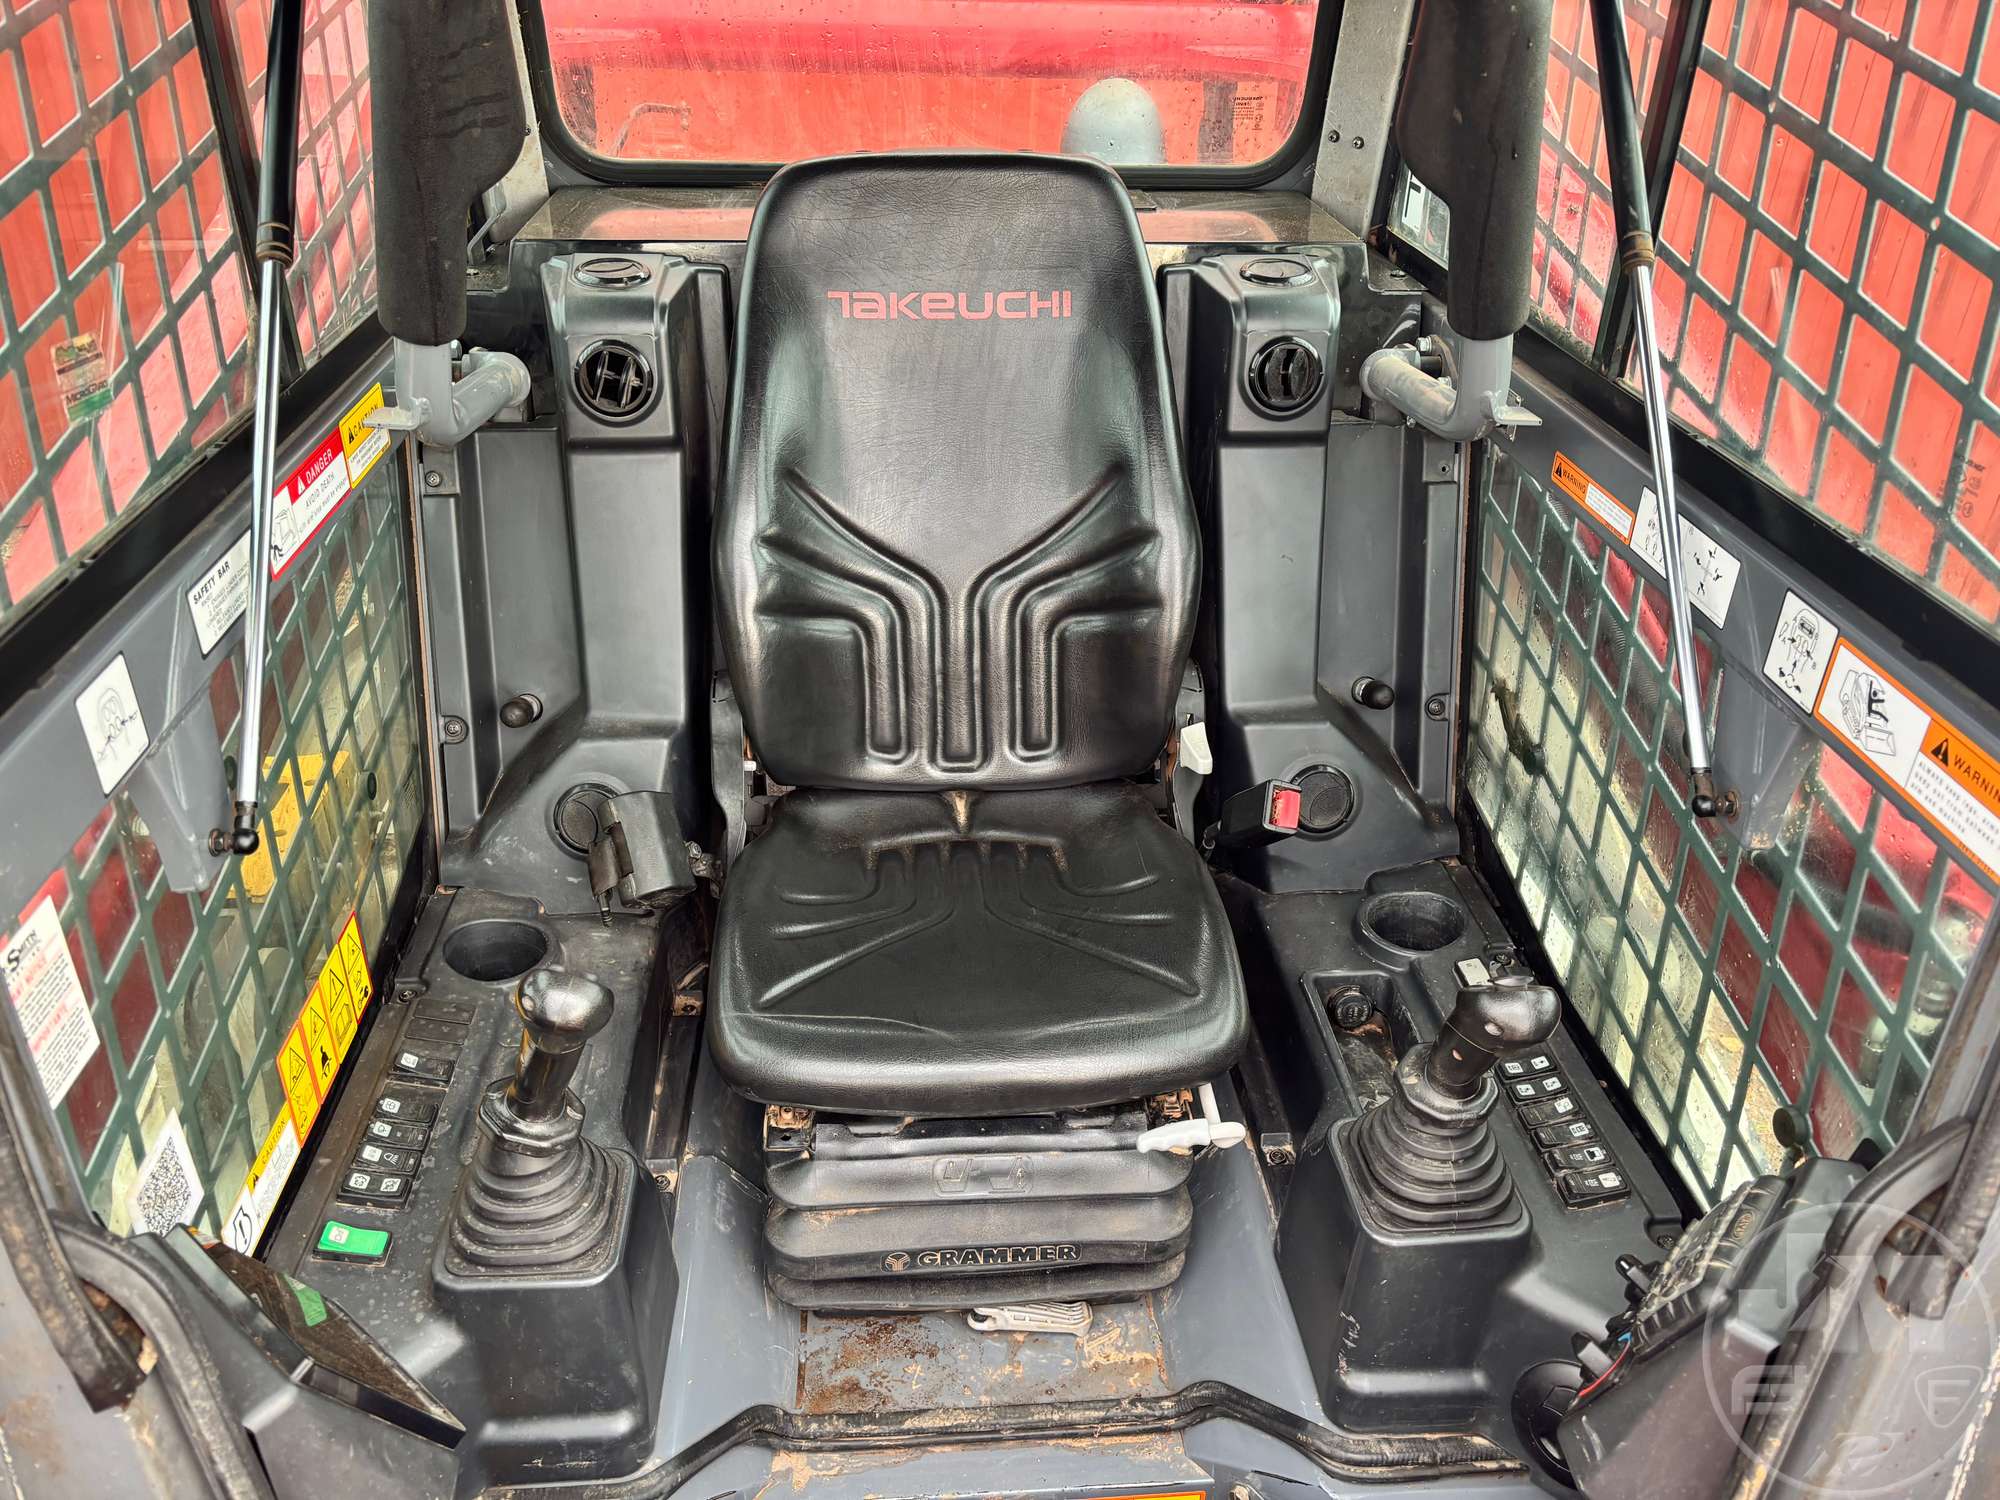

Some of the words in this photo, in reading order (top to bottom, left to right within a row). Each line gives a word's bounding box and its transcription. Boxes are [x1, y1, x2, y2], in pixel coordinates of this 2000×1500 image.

[305, 448, 333, 485] DANGER
[1562, 468, 1586, 494] WARNING
[193, 575, 216, 605] SAFETY
[217, 560, 231, 580] BAR
[262, 1119, 286, 1165] CAUTION
[917, 1245, 1079, 1267] GRAMMER
